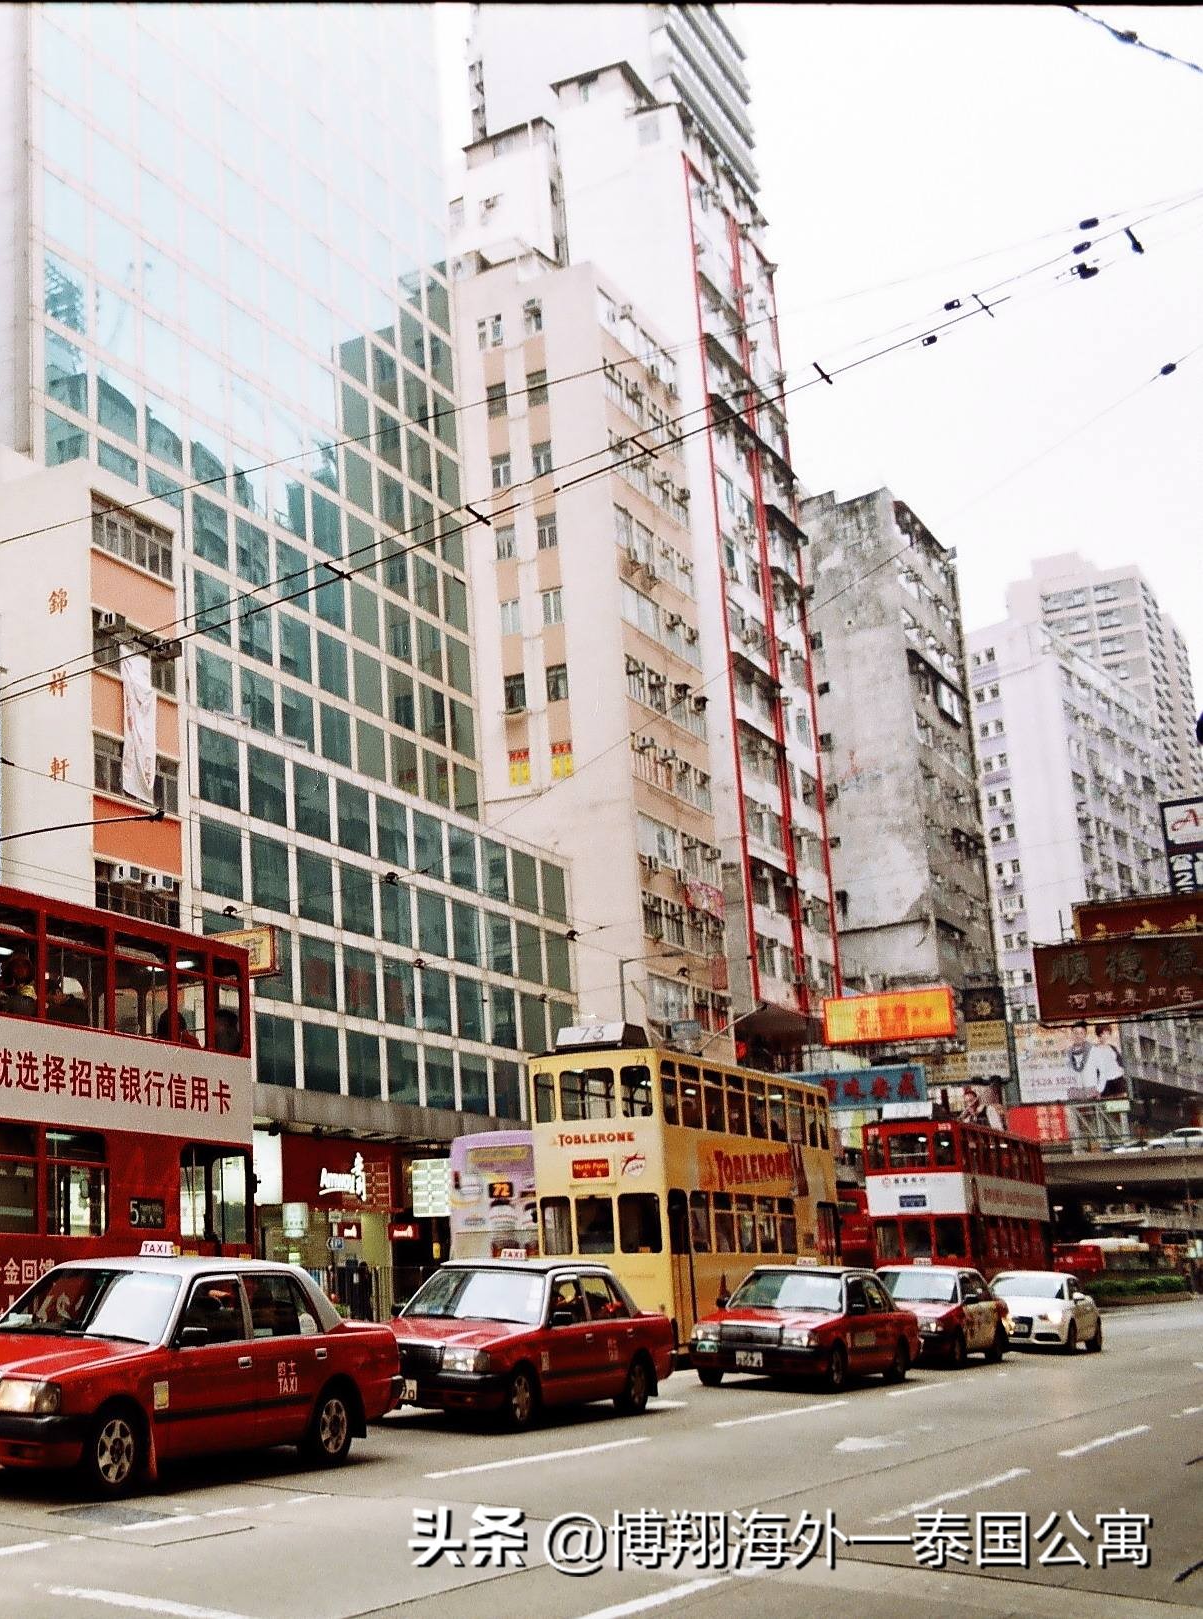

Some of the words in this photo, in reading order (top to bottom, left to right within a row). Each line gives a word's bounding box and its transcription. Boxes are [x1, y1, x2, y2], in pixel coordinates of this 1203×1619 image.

[580, 1026, 605, 1041] 73
[558, 1131, 636, 1147] TOBLERONE
[144, 1243, 167, 1255] TAXI
[278, 1377, 298, 1395] TAXI
